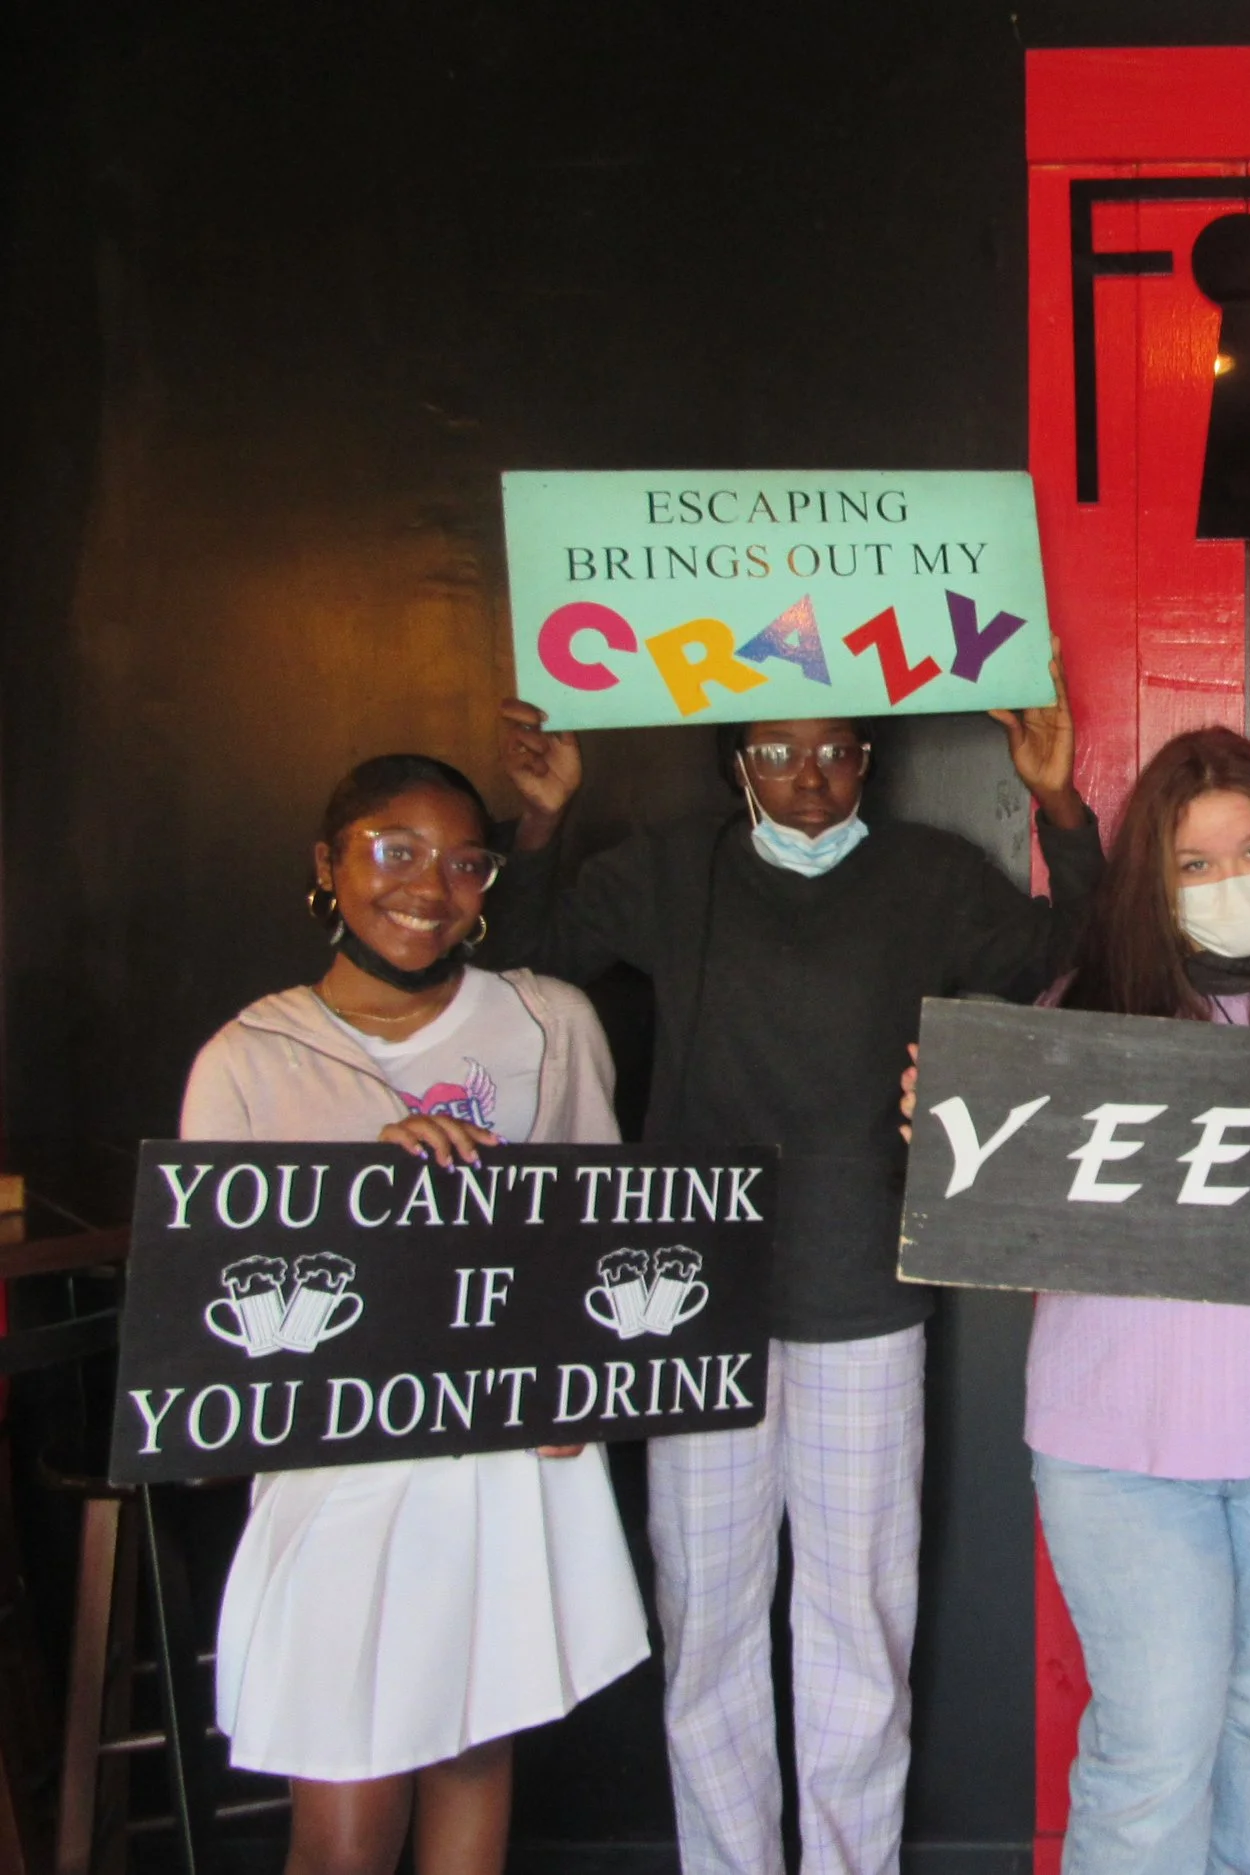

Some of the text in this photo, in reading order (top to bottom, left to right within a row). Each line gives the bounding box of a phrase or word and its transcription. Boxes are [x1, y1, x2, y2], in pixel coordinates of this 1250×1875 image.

[646, 489, 909, 525] ESCAPING
[566, 541, 988, 582] BRINGS OUT MY
[538, 589, 1028, 717] CRAZY
[158, 1163, 764, 1230] YOU CAN'T THINK
[449, 1267, 514, 1329] IF
[128, 1353, 754, 1455] YOU DON'T DRINK
